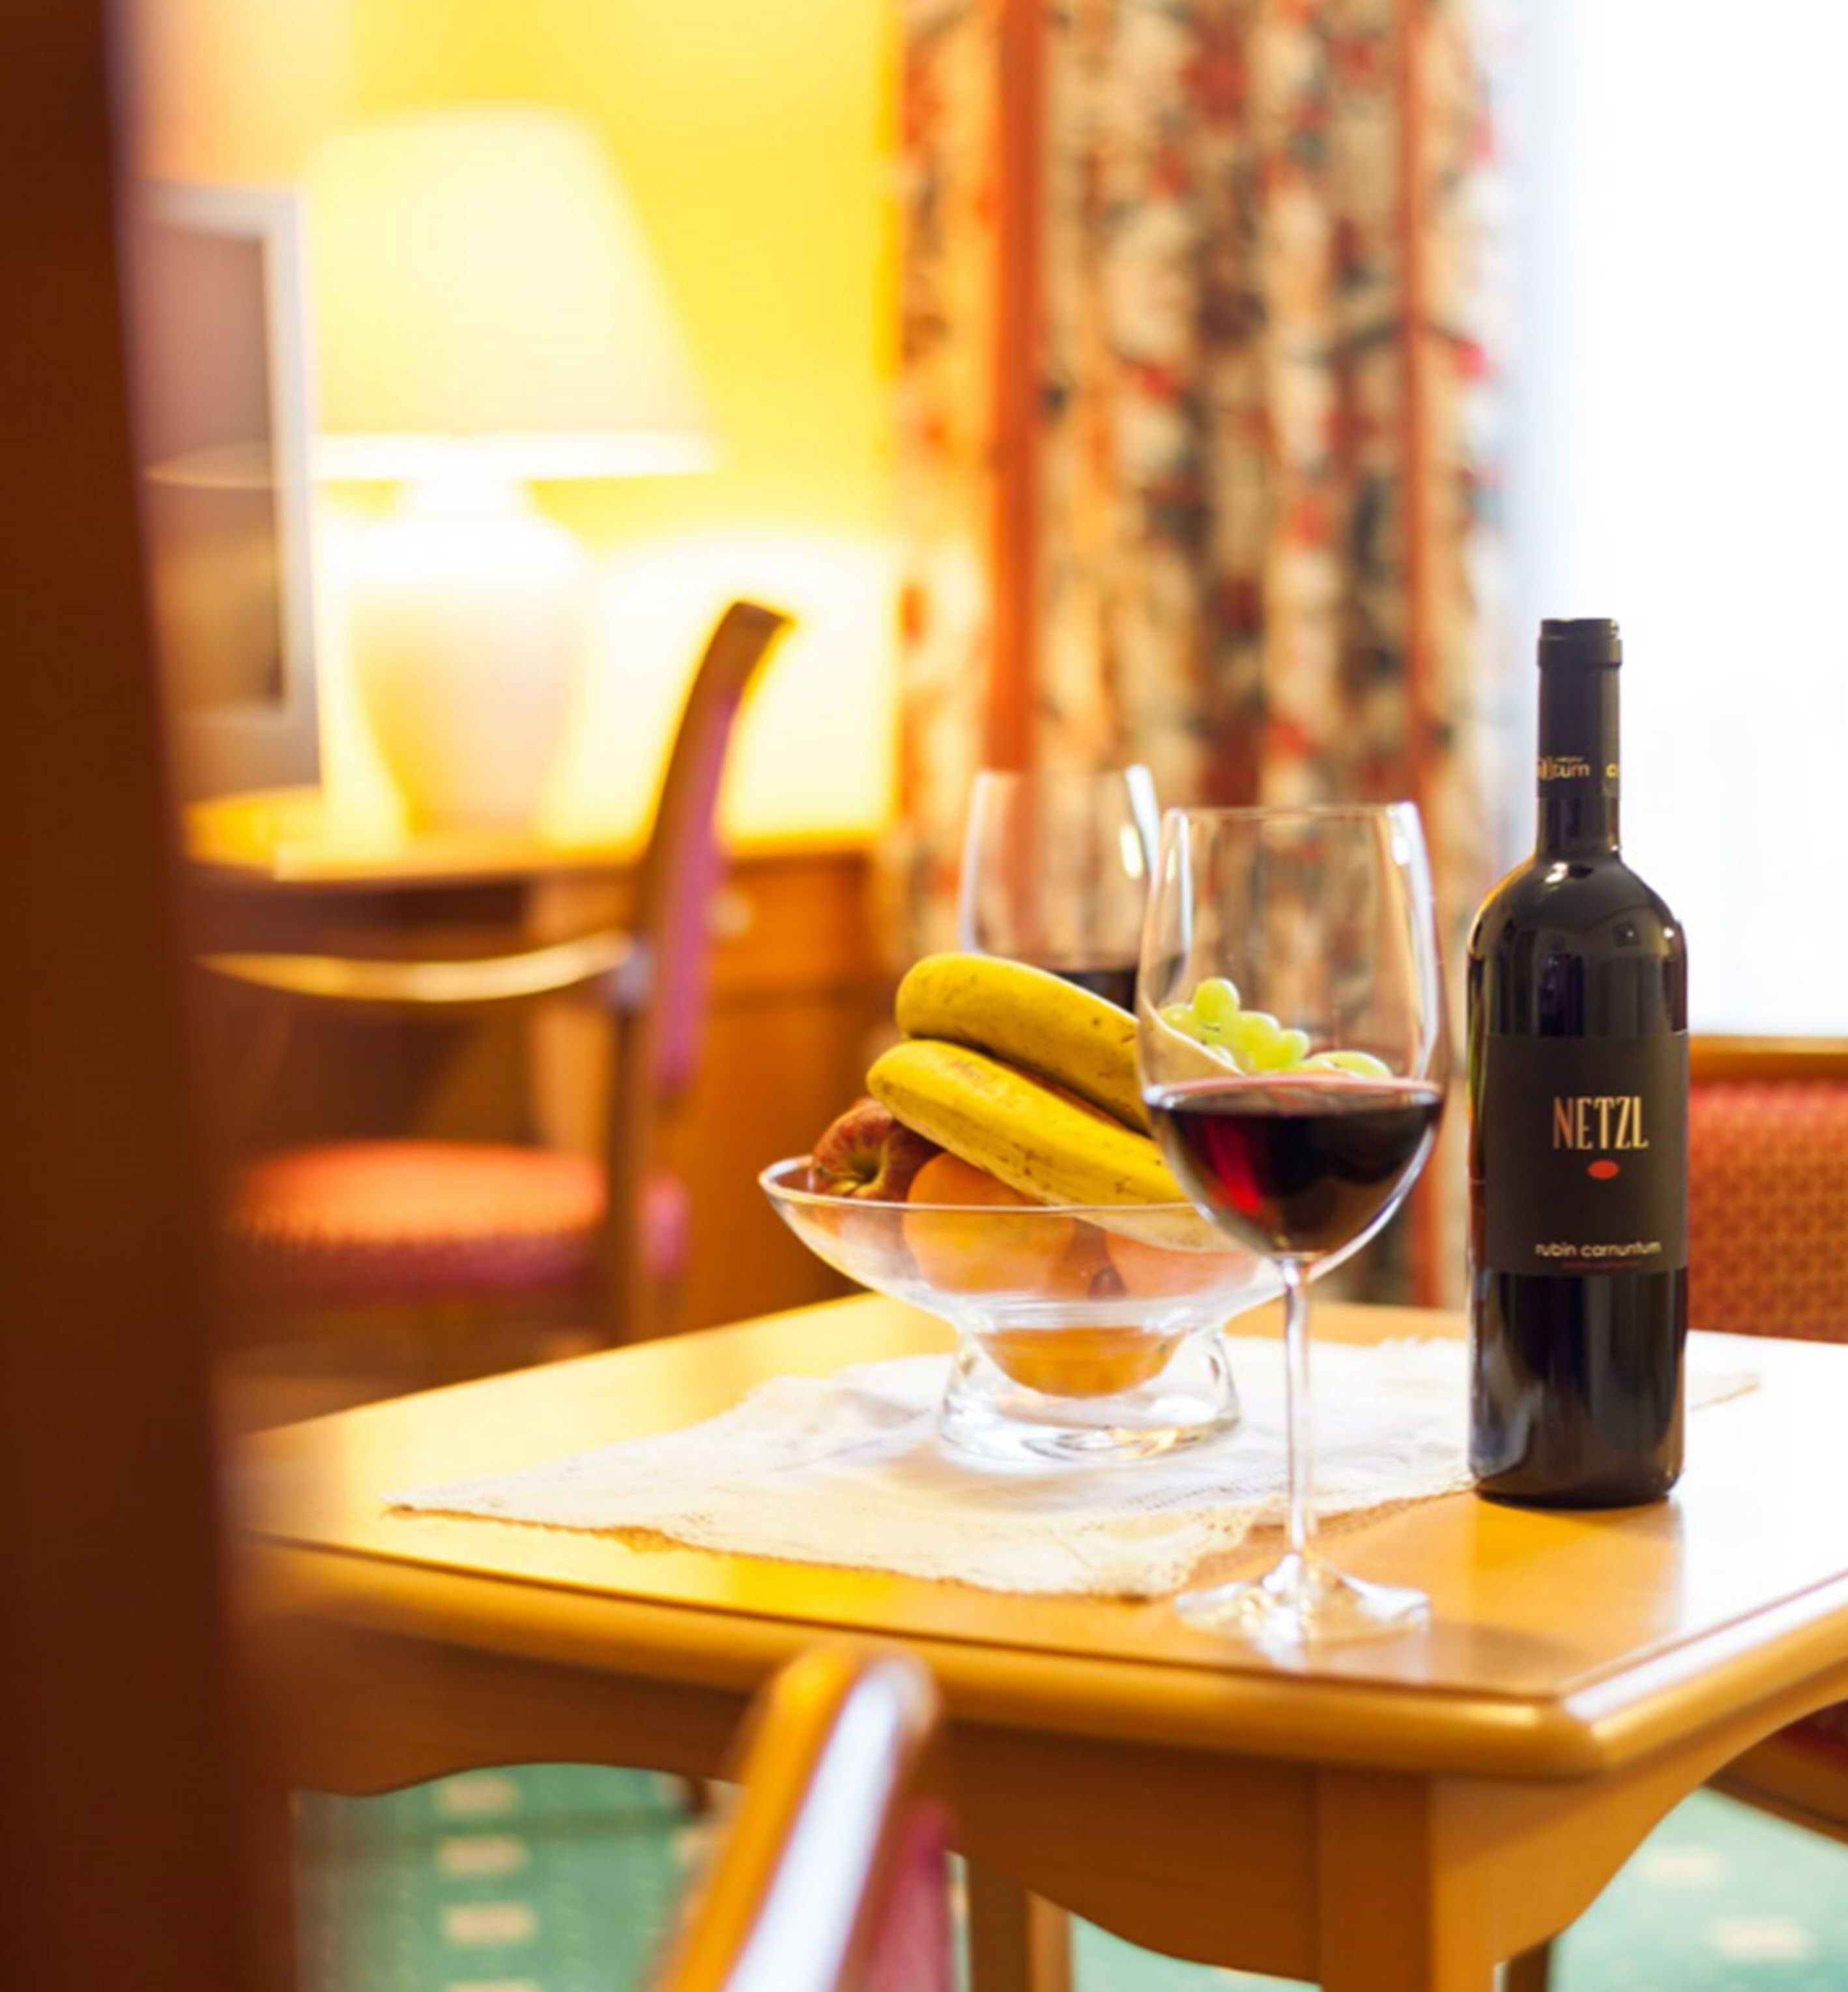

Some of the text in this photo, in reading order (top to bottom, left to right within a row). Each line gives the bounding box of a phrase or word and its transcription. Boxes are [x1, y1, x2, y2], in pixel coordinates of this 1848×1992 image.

[1553, 1096, 1649, 1149] NETZL
[1535, 1241, 1661, 1258] rubin carnuntum
